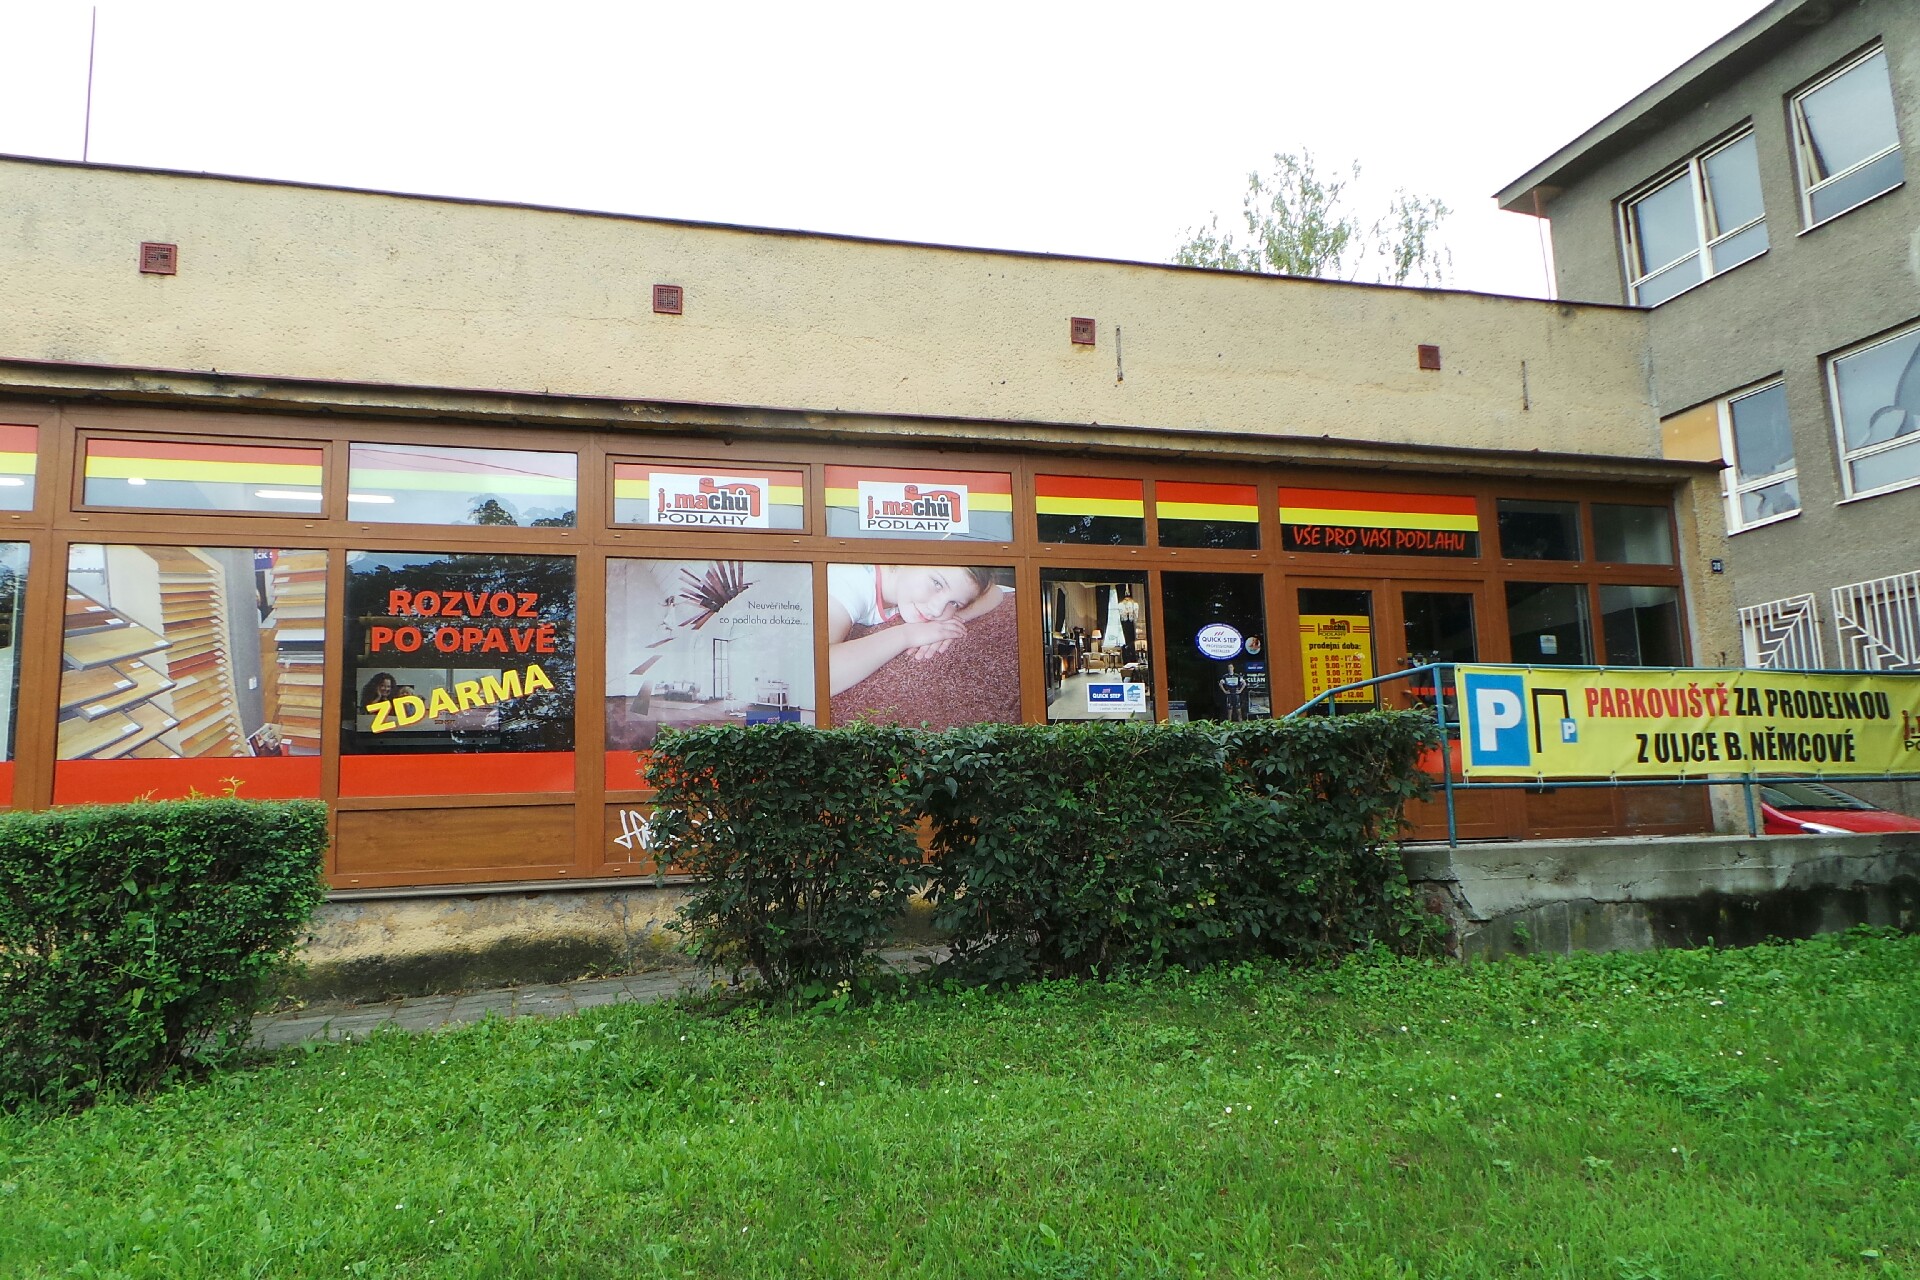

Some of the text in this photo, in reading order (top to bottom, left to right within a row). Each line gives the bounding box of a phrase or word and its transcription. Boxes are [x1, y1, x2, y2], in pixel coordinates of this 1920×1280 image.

[658, 513, 748, 525] PODLAHY
[867, 519, 949, 531] PODLAHY
[1325, 527, 1357, 547] PRO
[1395, 530, 1466, 551] PODLAHU
[389, 589, 538, 618] ROZVOZ
[748, 601, 803, 612] Neuvěřitelné,
[732, 614, 767, 625] podlaha
[769, 614, 809, 625] dokáže...
[371, 623, 555, 653] PO OPAVĚ
[366, 664, 554, 734] ZDARMA
[1585, 682, 1891, 720] PARKOVIŠTĚ ZA PRODEJNOU
[1475, 688, 1522, 751] P
[1562, 722, 1576, 739] P
[1636, 726, 1856, 763] Z ULICE B. NĚMCOVÉ
